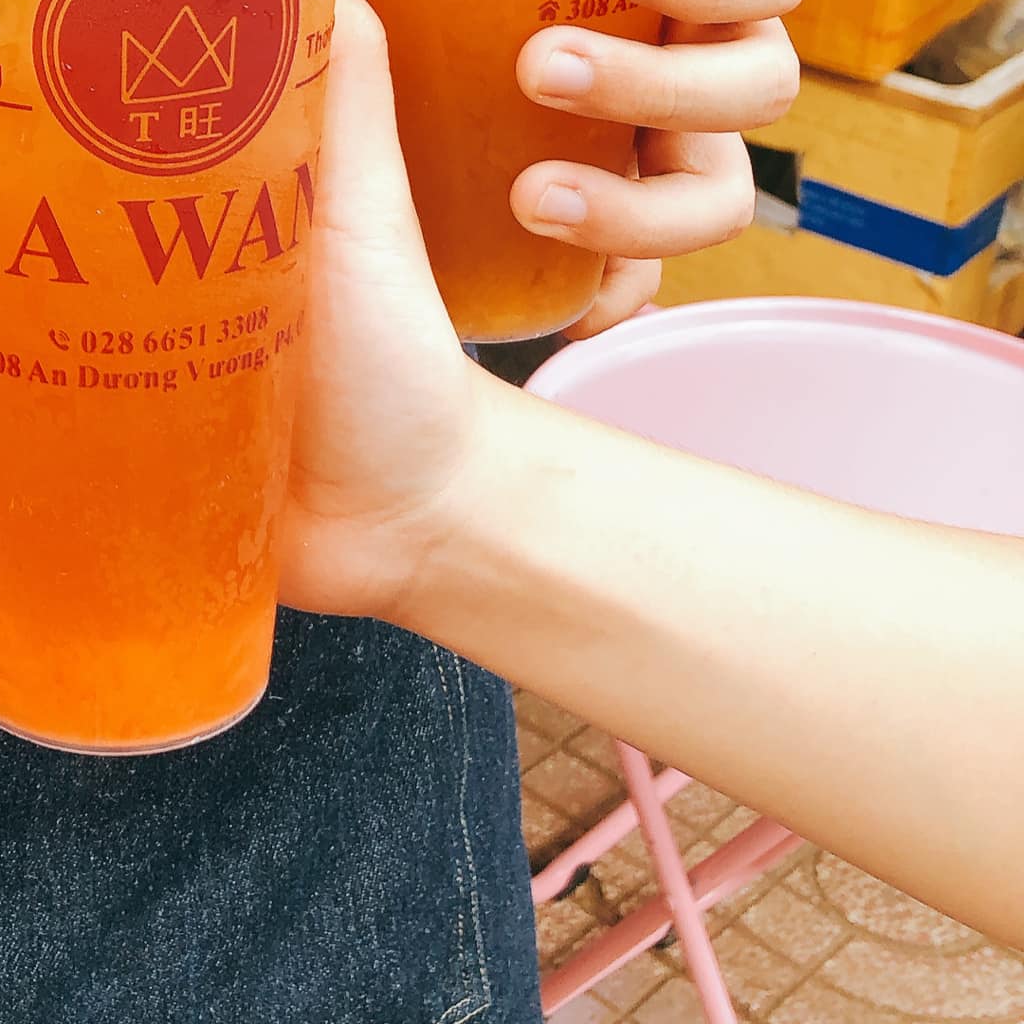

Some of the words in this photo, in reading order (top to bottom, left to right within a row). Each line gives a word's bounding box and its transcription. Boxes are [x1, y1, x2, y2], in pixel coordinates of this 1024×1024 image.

[129, 111, 160, 143] T
[178, 102, 225, 142] 旺
[117, 161, 315, 286] WAN
[80, 329, 135, 355] 028
[142, 323, 208, 354] 6651
[215, 304, 270, 345] 3308
[28, 359, 68, 387] An
[78, 364, 178, 393] Dương
